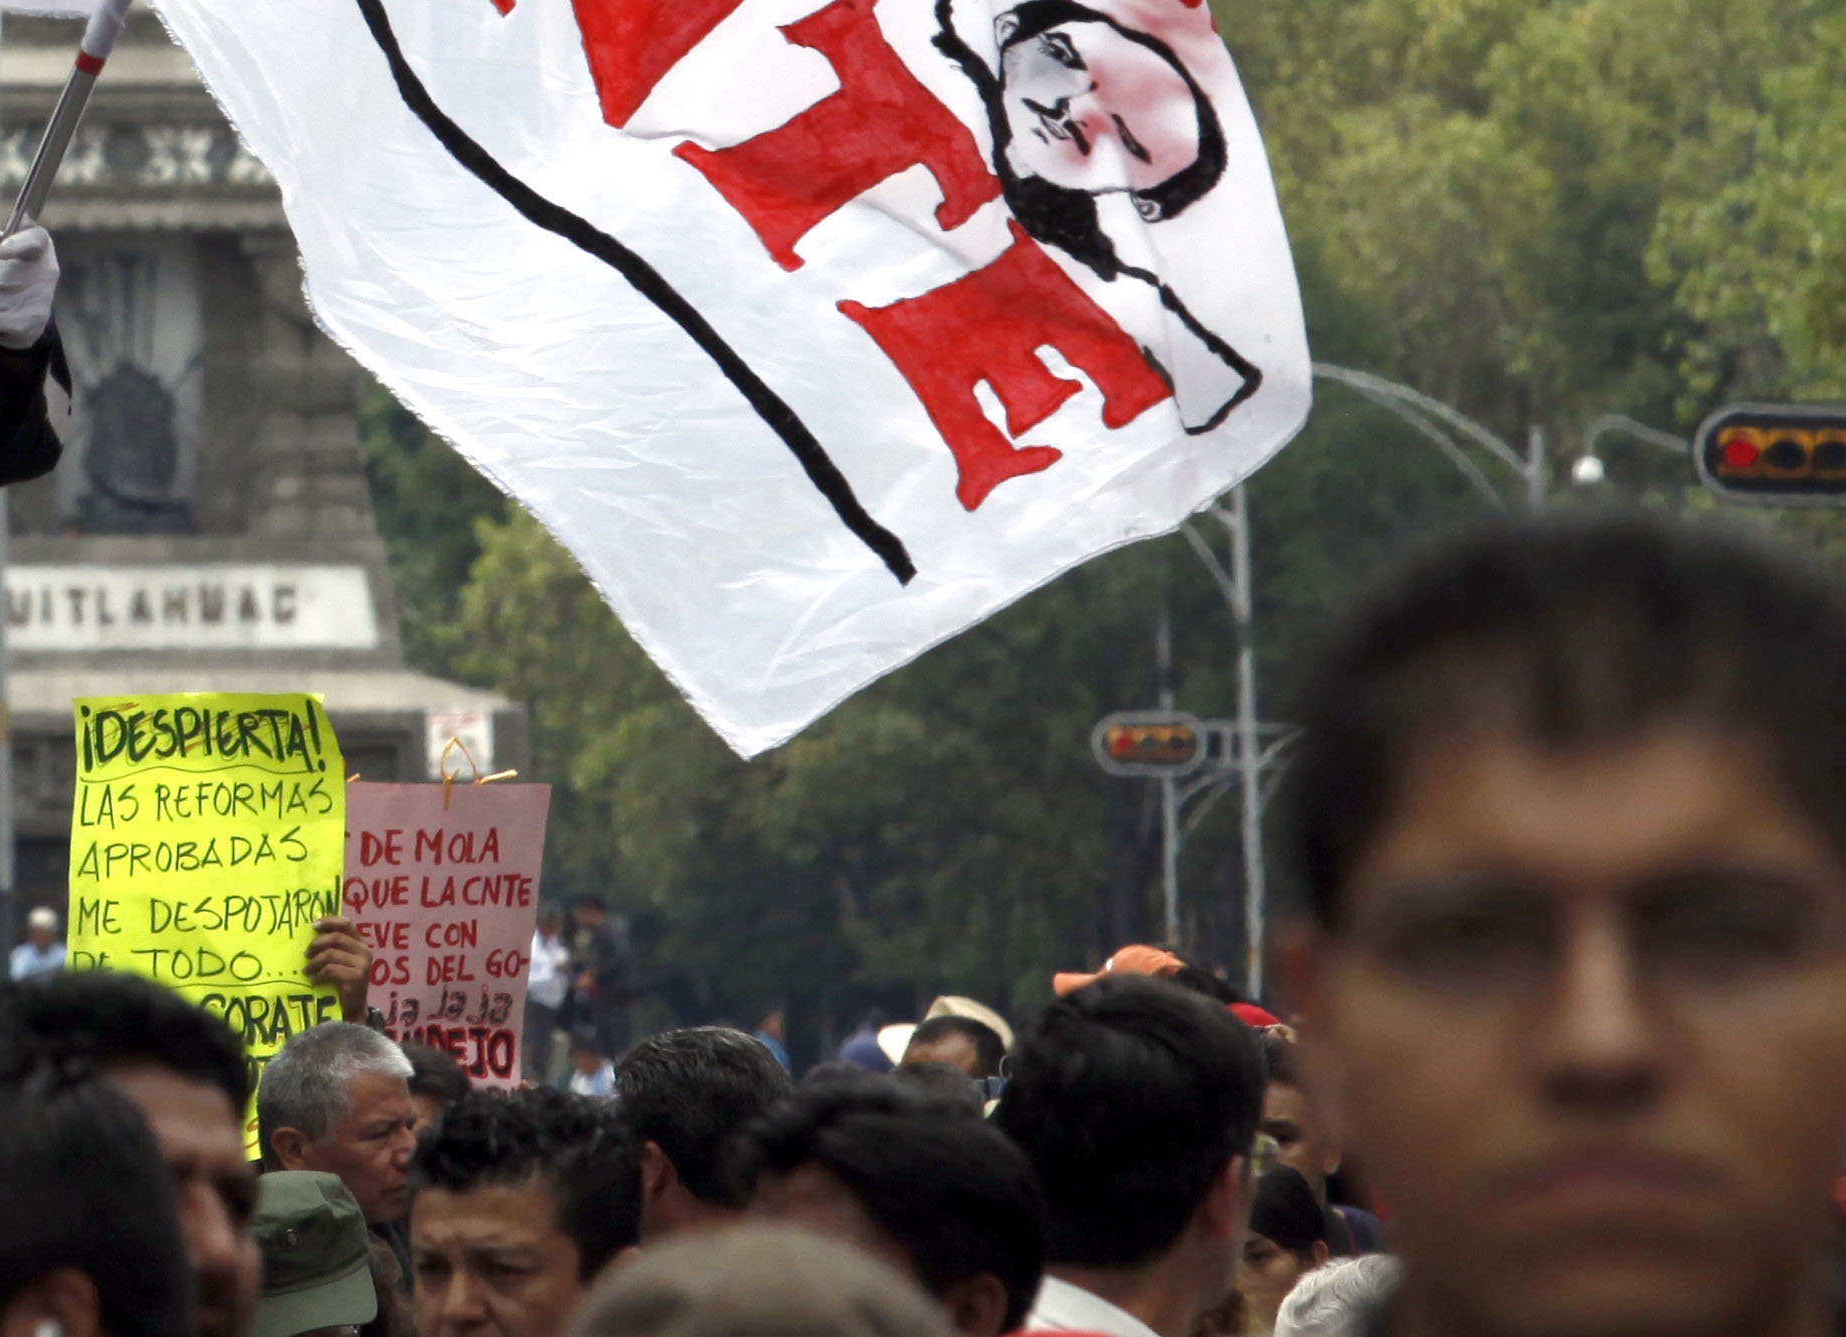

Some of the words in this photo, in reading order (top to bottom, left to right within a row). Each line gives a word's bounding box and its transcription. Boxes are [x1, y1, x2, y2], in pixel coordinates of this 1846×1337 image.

[80, 698, 327, 774] ¡DESPIERTA!
[79, 783, 140, 830] LAS
[154, 777, 333, 823] REFORMAS
[77, 825, 309, 882] APROBADAS
[359, 828, 403, 866] DE
[413, 826, 500, 865] MOLA
[77, 896, 123, 937] ME
[149, 874, 341, 939] DESPOJARON
[342, 874, 411, 915] QUE
[461, 873, 533, 908] CNTE
[424, 918, 478, 949] CON
[425, 954, 475, 986] DEL
